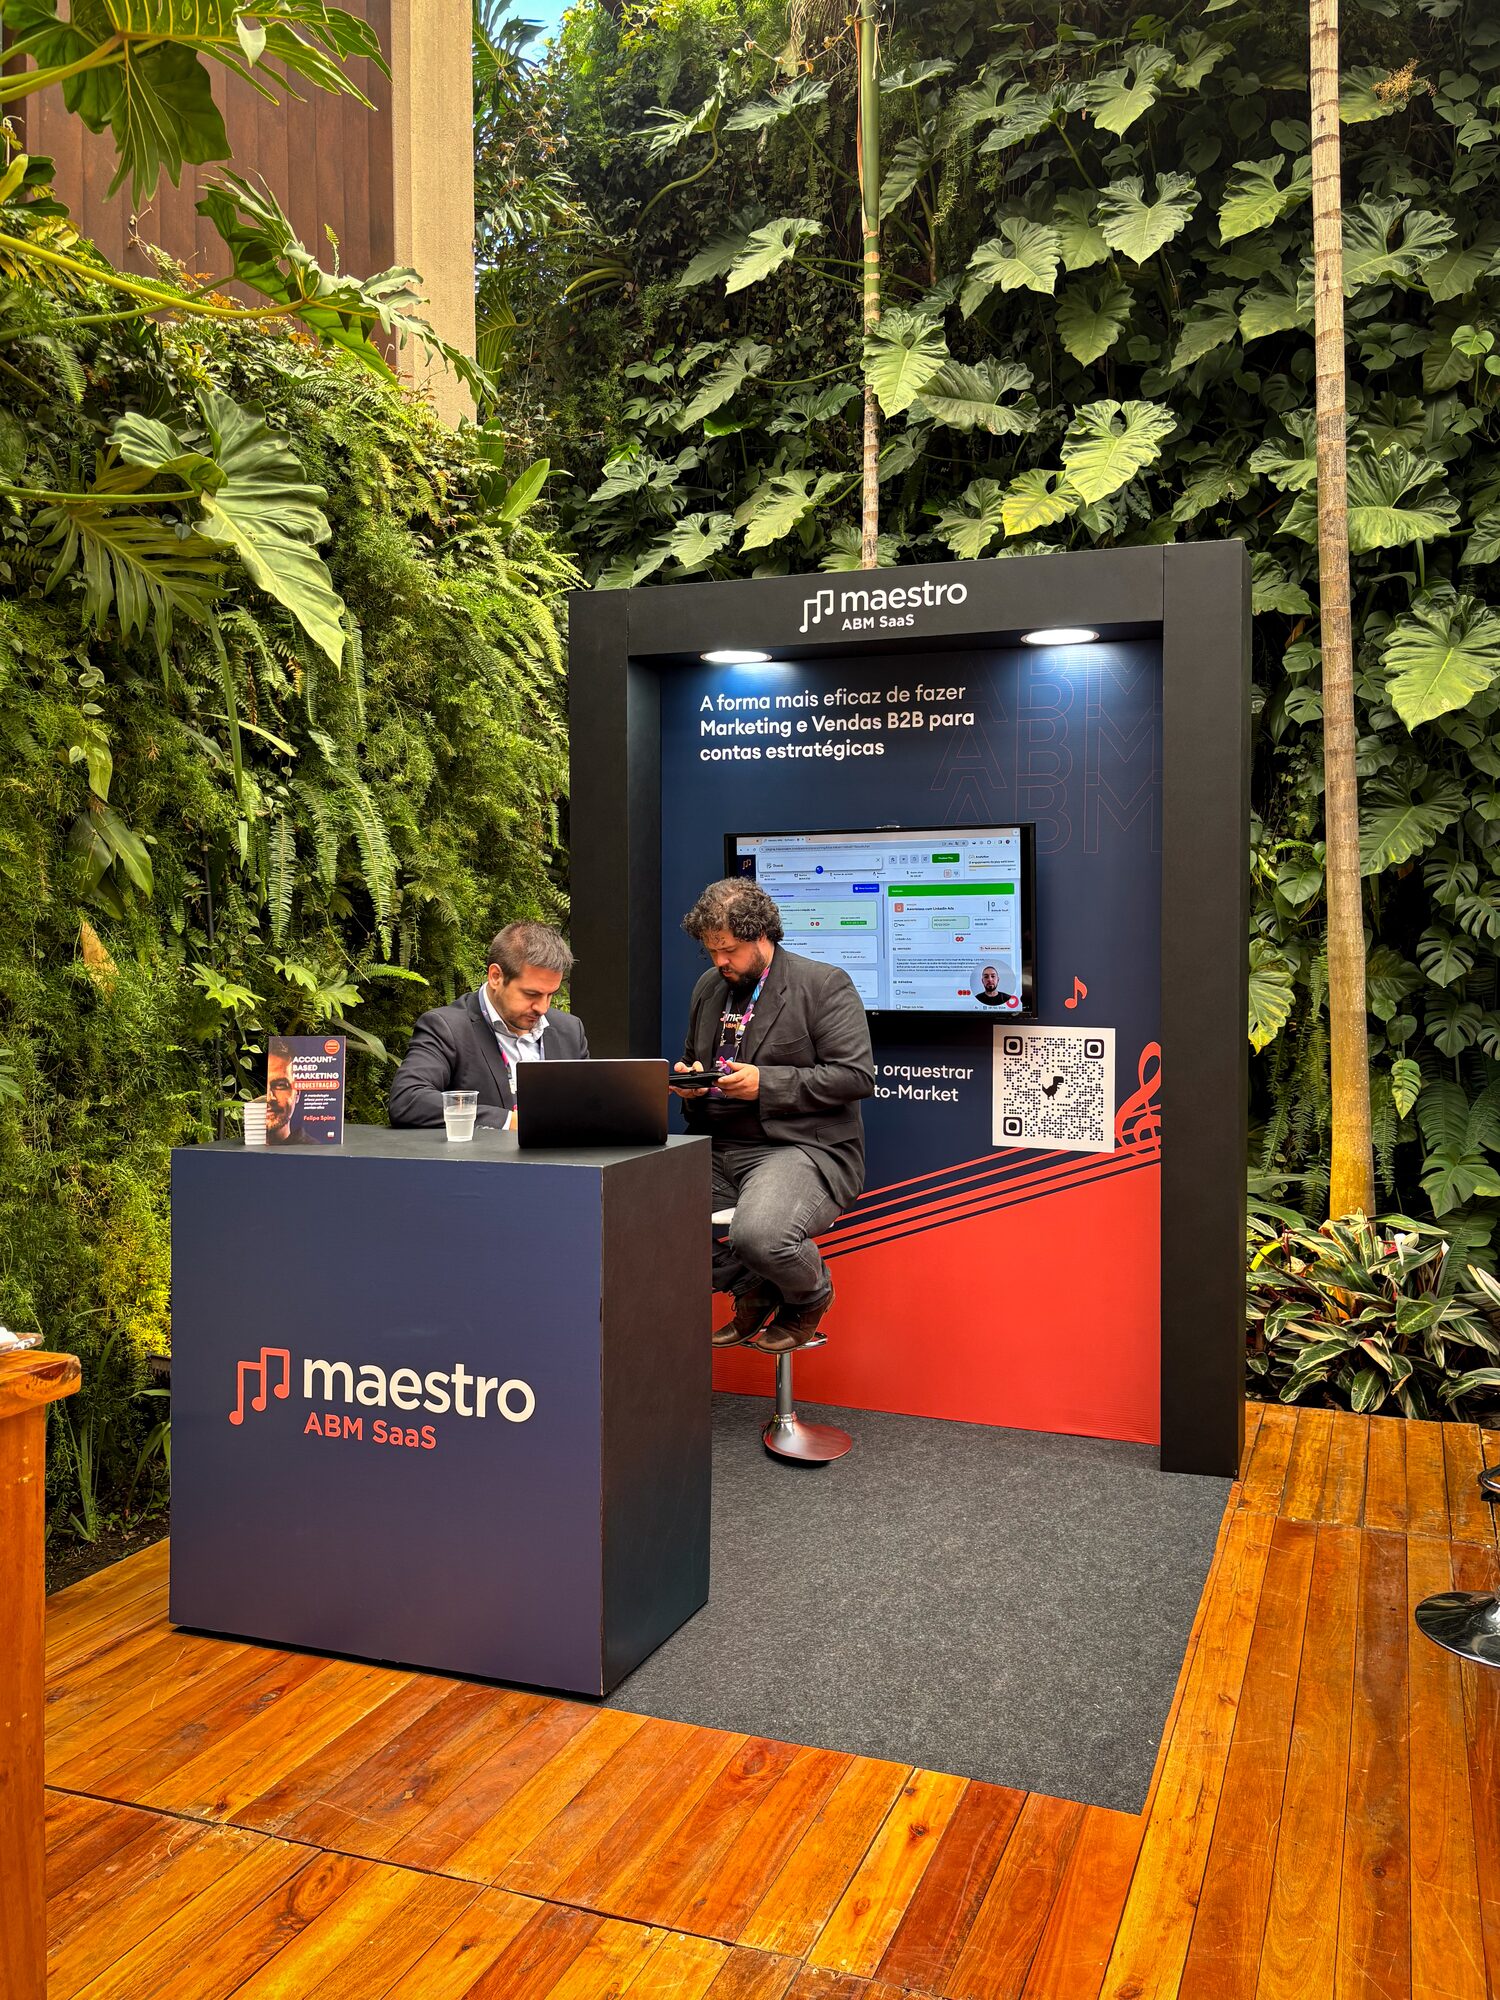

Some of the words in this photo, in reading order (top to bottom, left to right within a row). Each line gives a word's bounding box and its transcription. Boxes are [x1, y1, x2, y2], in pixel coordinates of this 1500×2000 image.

[841, 580, 968, 613] maestro
[841, 616, 875, 631] ABM
[879, 613, 915, 628] SaaS
[700, 695, 714, 712] A
[717, 693, 771, 711] forma
[775, 690, 819, 708] mais
[823, 687, 881, 706] eficaz
[886, 686, 910, 703] de
[915, 684, 966, 702] fazer
[700, 717, 792, 738] Marketing
[796, 720, 807, 733] e
[811, 713, 882, 732] Vendas
[887, 711, 924, 729] B2B
[929, 711, 975, 731] para
[700, 744, 762, 761] contas
[765, 739, 885, 761] estratégicas
[883, 1064, 974, 1081] orquestrar
[303, 1358, 536, 1423] maestro
[303, 1411, 363, 1441] ABM
[372, 1419, 437, 1450] SaaS
